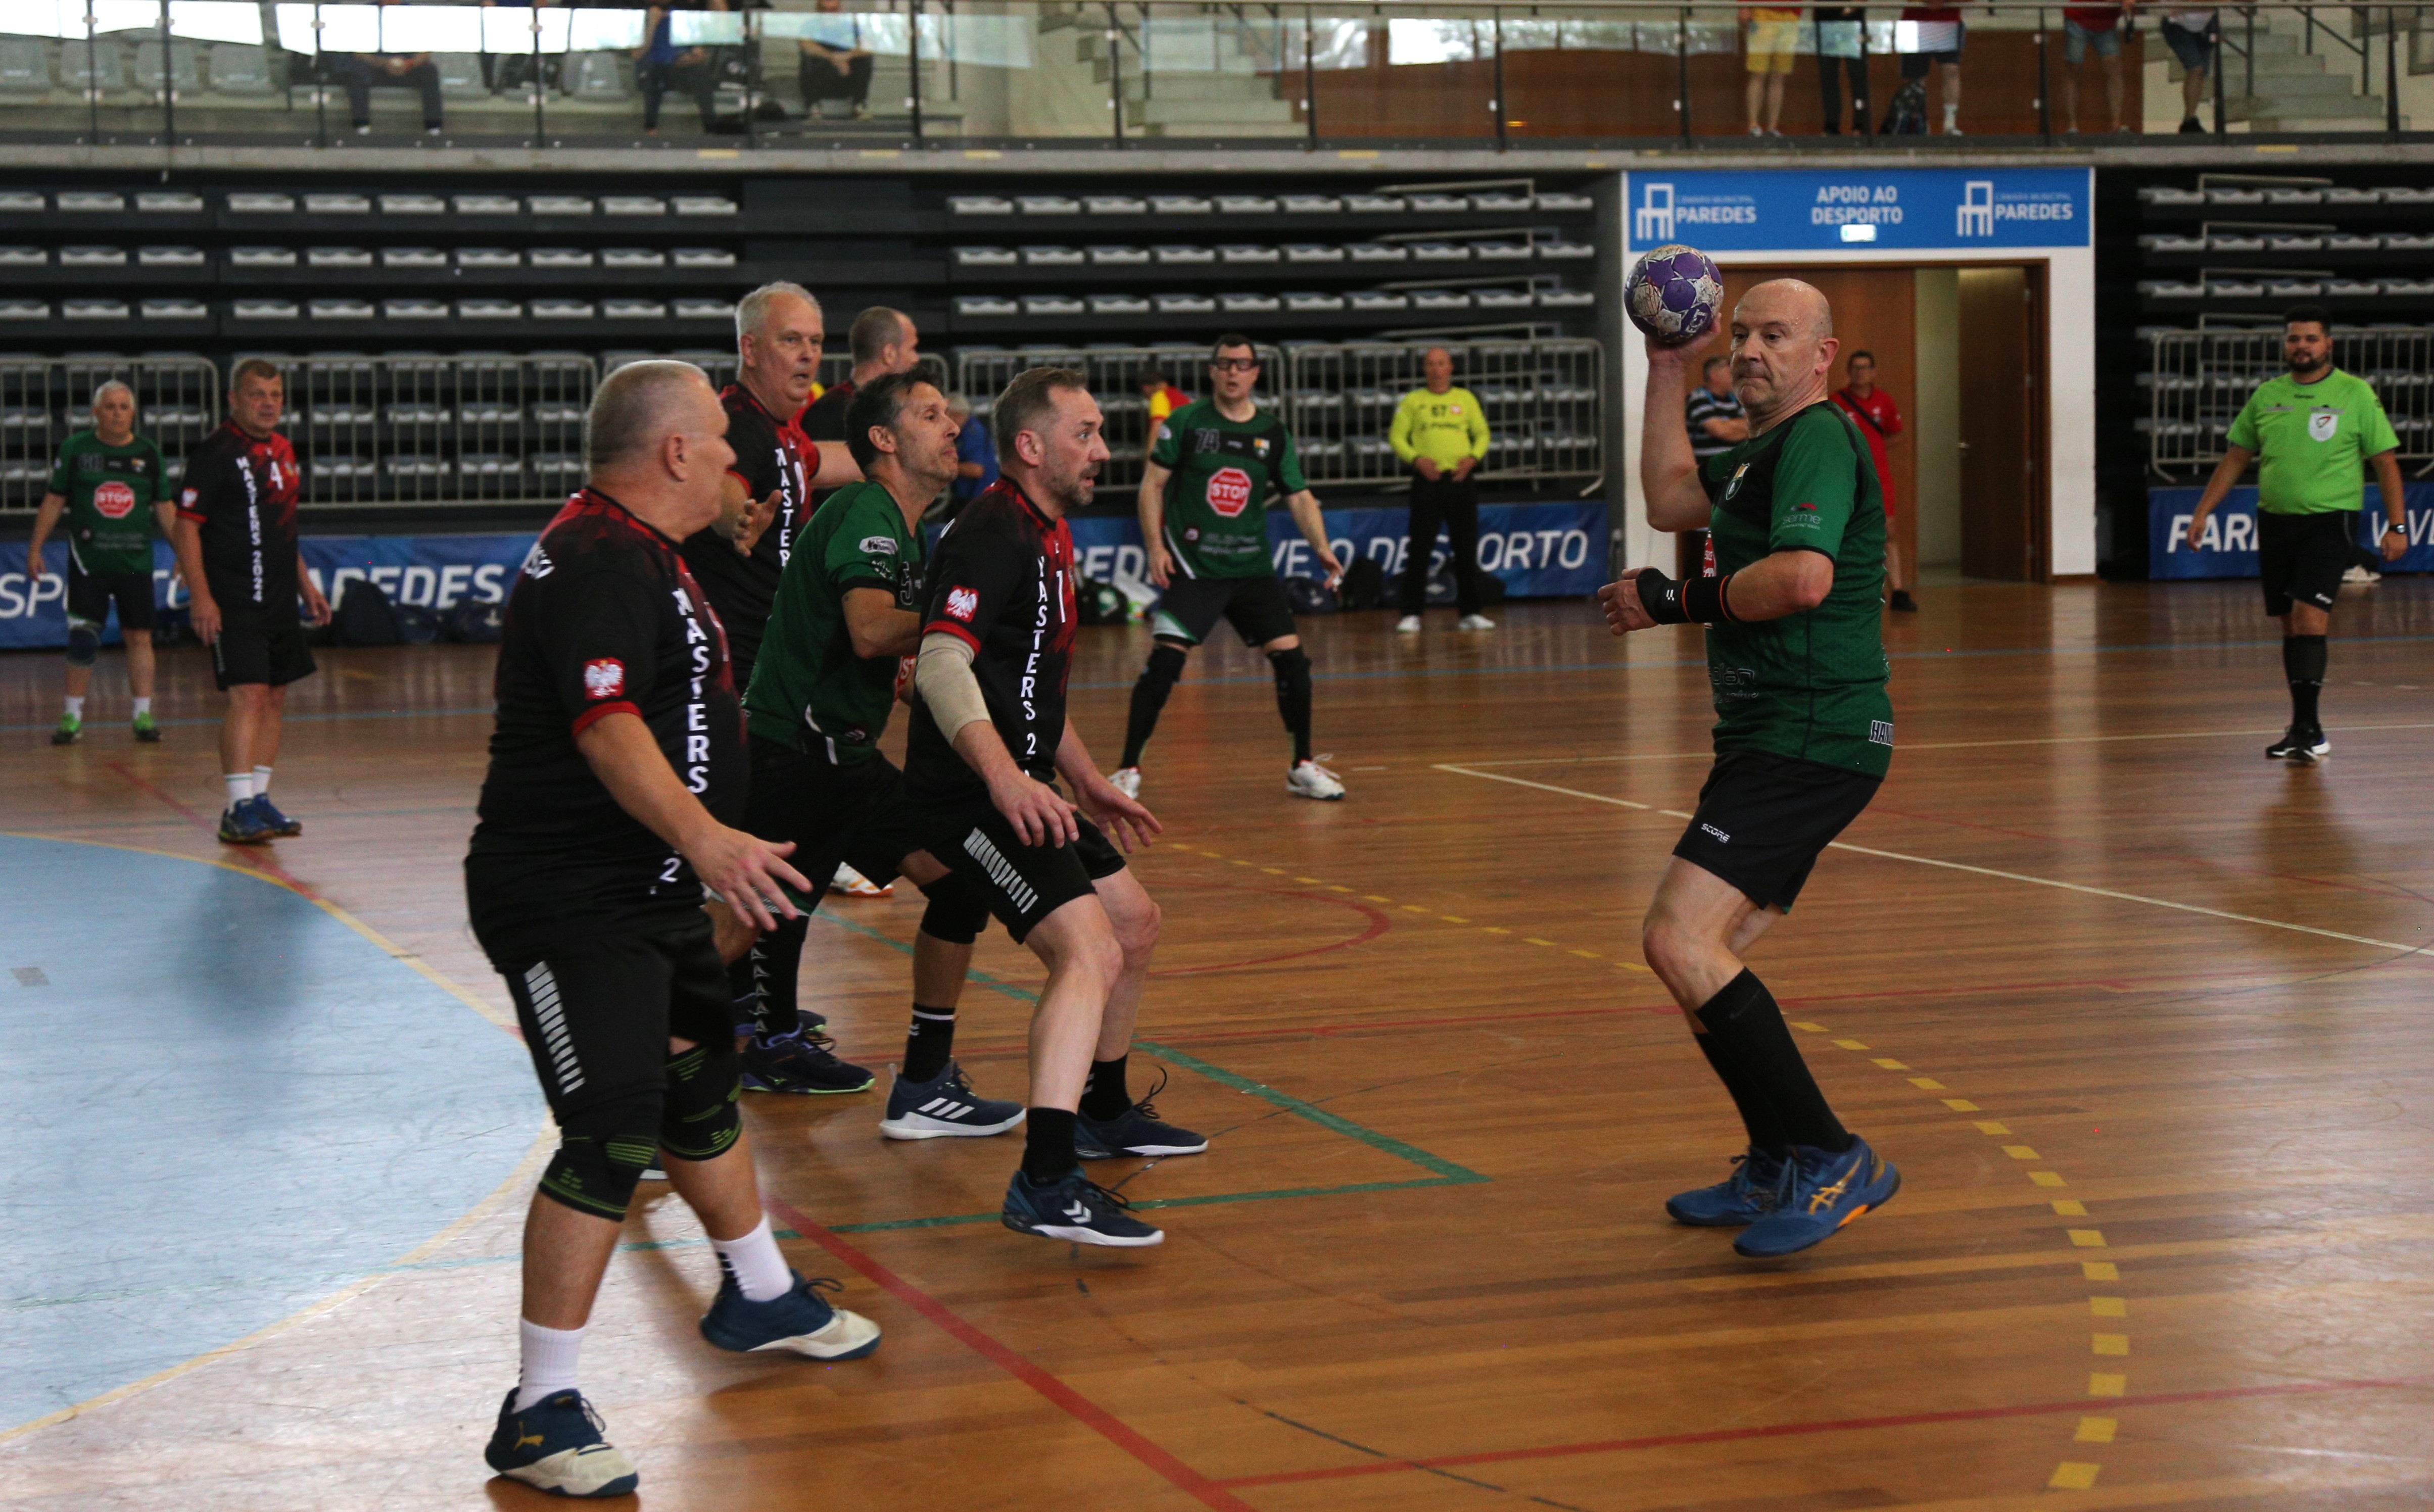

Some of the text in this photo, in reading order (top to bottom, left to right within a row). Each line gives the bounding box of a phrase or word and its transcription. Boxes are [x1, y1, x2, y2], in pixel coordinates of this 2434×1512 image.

[1817, 185, 1897, 204] APOIO AO
[1676, 206, 1757, 224] PAREDES
[1811, 207, 1903, 224] DESPORTO
[1995, 203, 2073, 220] PAREDES
[270, 461, 284, 491] 4
[1211, 482, 1249, 499] STOP
[775, 448, 794, 567] MASTER
[235, 456, 263, 602] MASTERS 2024
[1056, 570, 1066, 623] 1
[1701, 823, 1730, 842] SCORE
